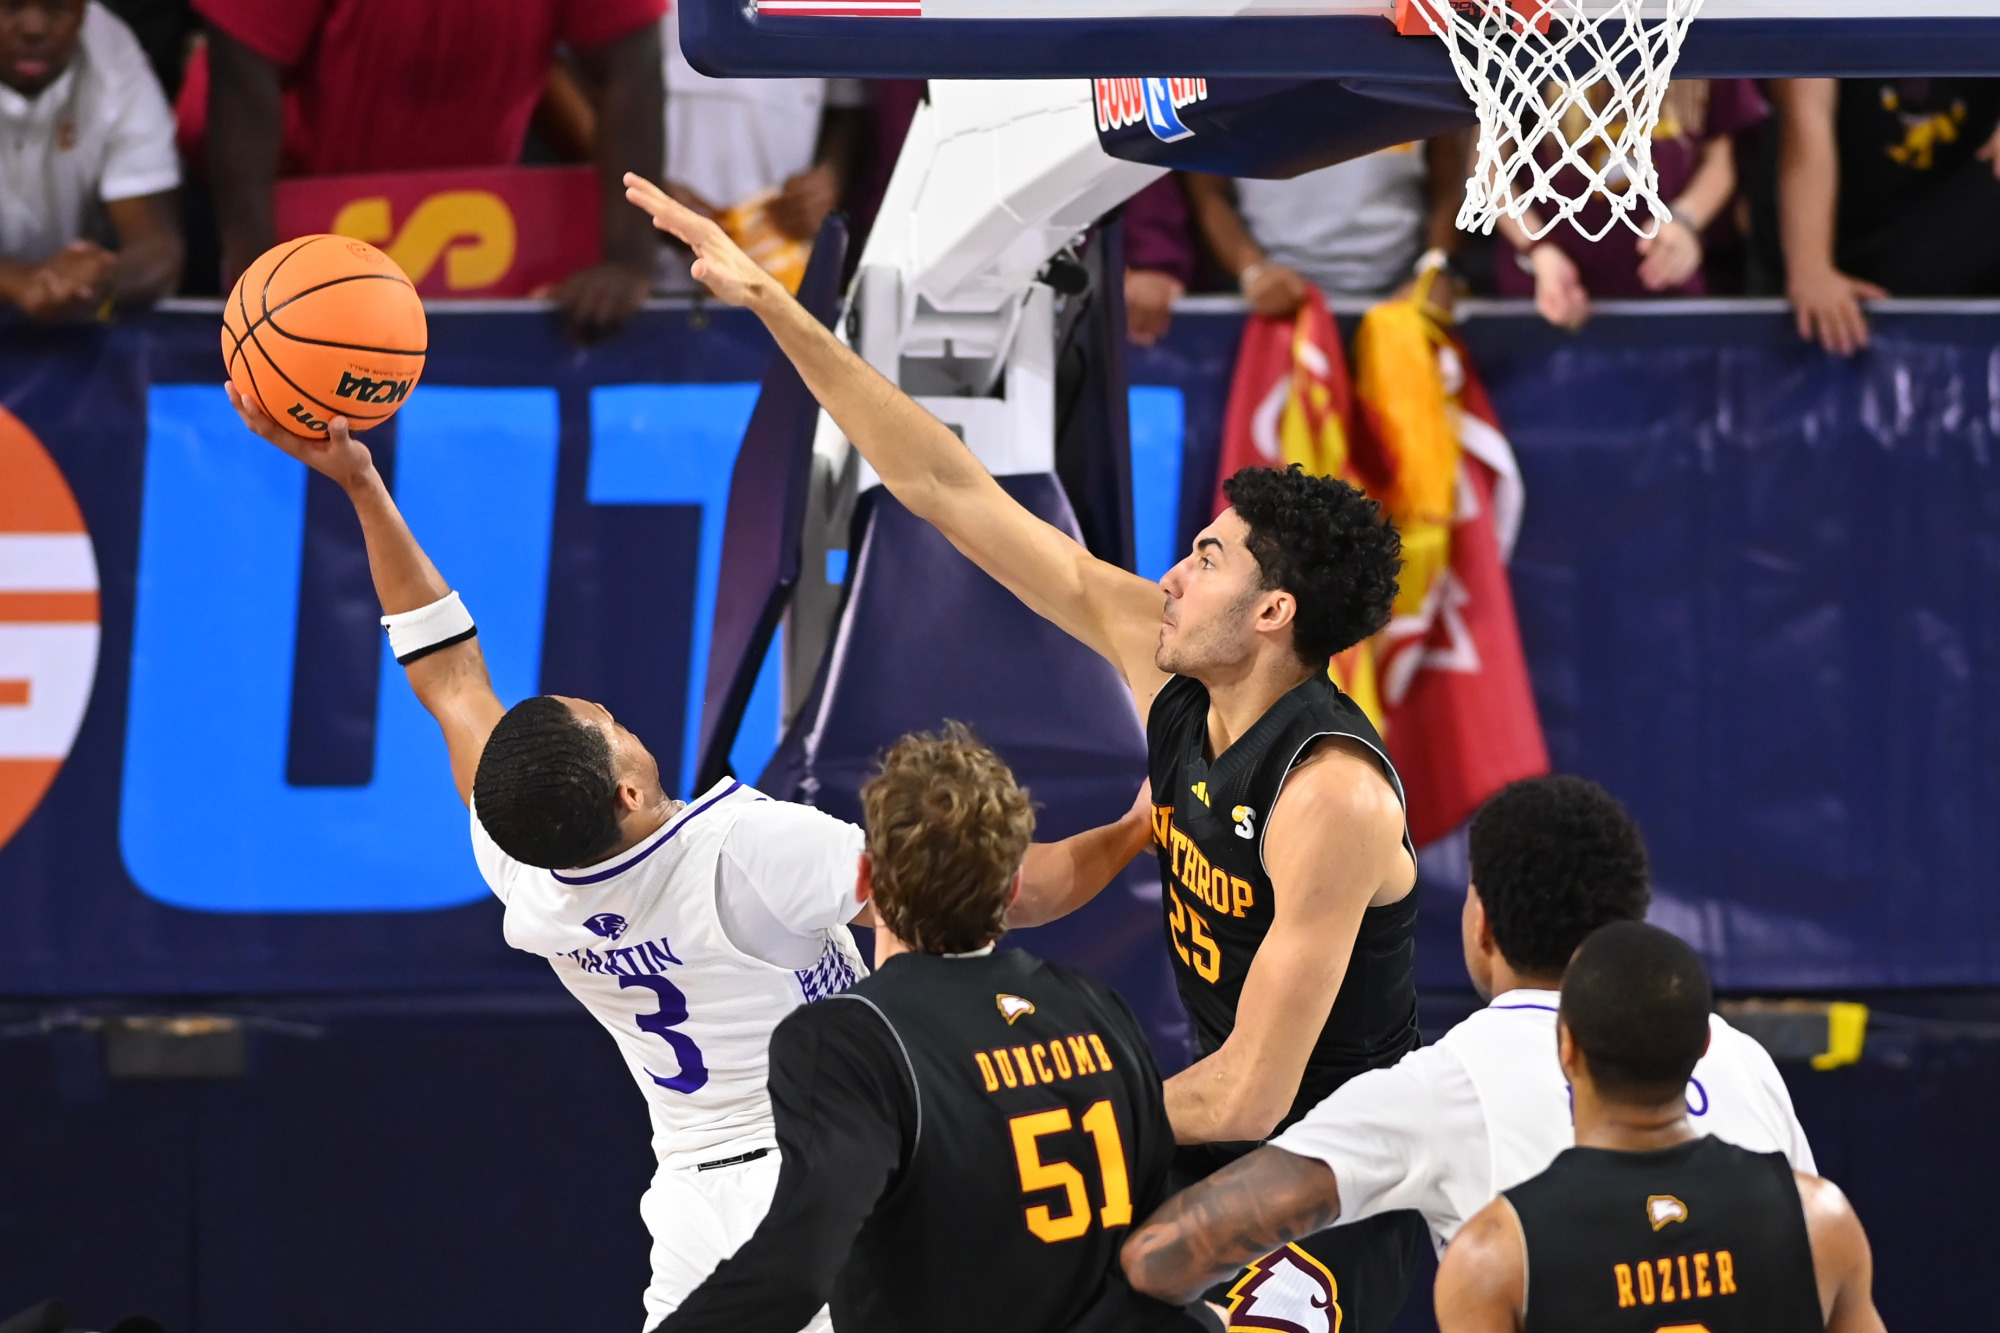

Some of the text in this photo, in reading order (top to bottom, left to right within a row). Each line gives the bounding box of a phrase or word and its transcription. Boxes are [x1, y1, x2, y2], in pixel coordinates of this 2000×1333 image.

[335, 371, 414, 403] NCAA
[1151, 804, 1254, 918] NTHROP
[618, 974, 708, 1094] 3
[974, 1034, 1113, 1092] DUNCOMB
[1009, 1100, 1133, 1243] 51
[1614, 1250, 1737, 1308] ROZIER
